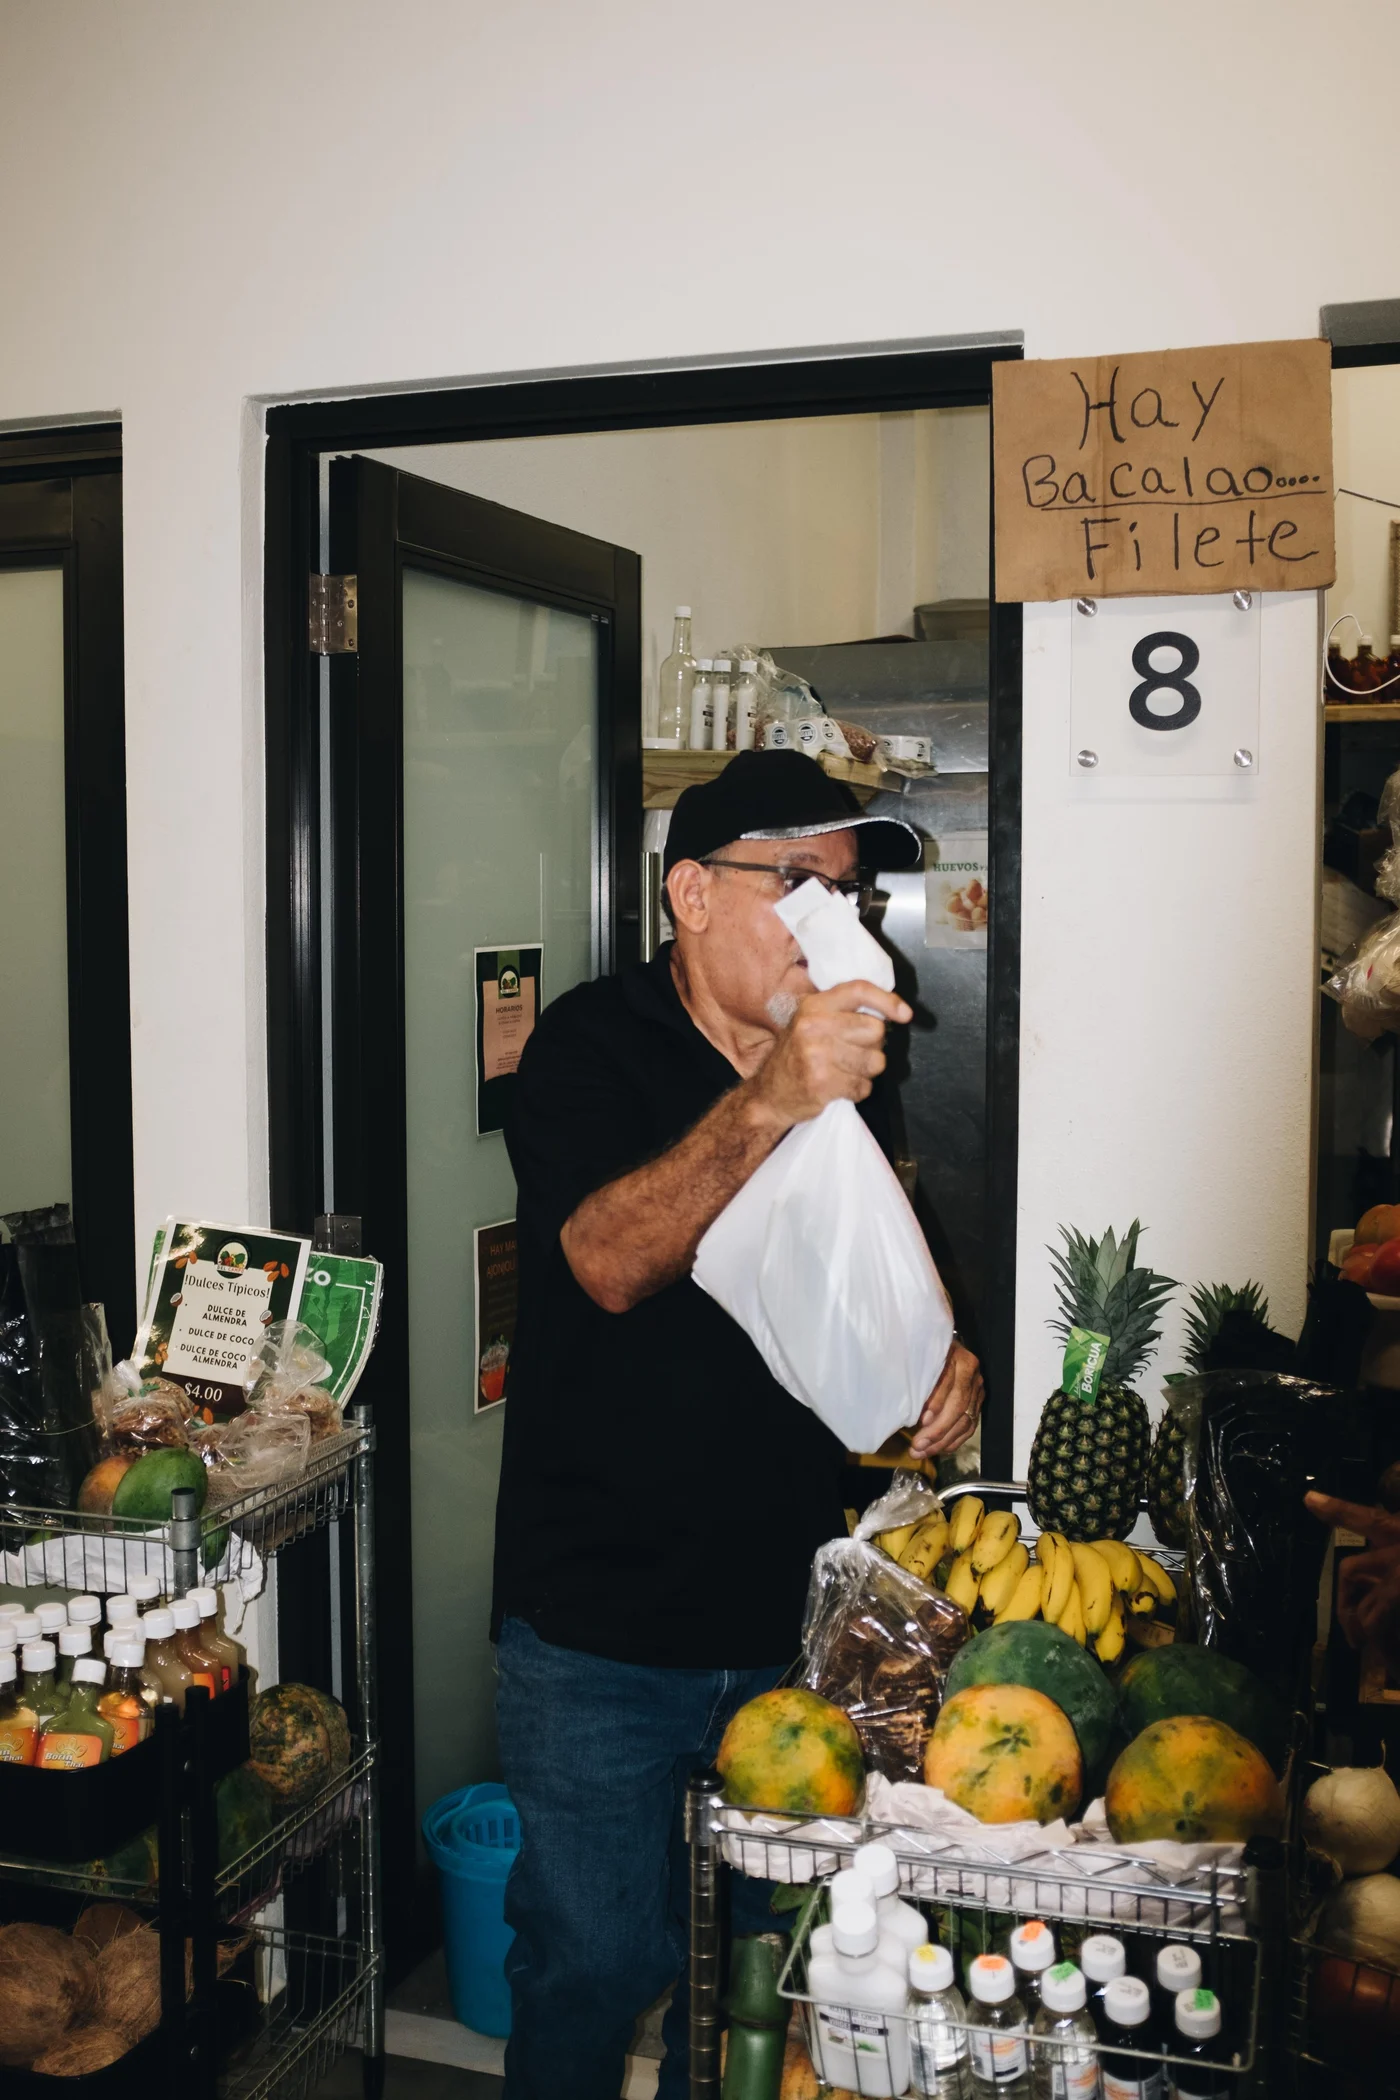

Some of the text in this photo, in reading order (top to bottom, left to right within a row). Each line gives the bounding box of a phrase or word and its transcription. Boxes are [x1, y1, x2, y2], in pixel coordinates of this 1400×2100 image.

[1071, 366, 1225, 449] Hay
[1080, 510, 1319, 580] Filete
[1128, 631, 1202, 731] 8
[933, 862, 979, 872] HUEVOS
[495, 1004, 523, 1014] HORARIOS
[489, 1242, 504, 1257] HAY
[184, 1274, 270, 1299] !Dulces Típicos!
[202, 1312, 247, 1326] ALMENDRA
[207, 1304, 246, 1318] DULCE DE
[188, 1327, 254, 1346] DULCE DE COCO
[180, 1343, 247, 1362] DULCE DE COCO
[192, 1355, 238, 1370] ALMENDRA
[1081, 1342, 1102, 1394] BORICUA
[184, 1382, 223, 1402] $4.00
